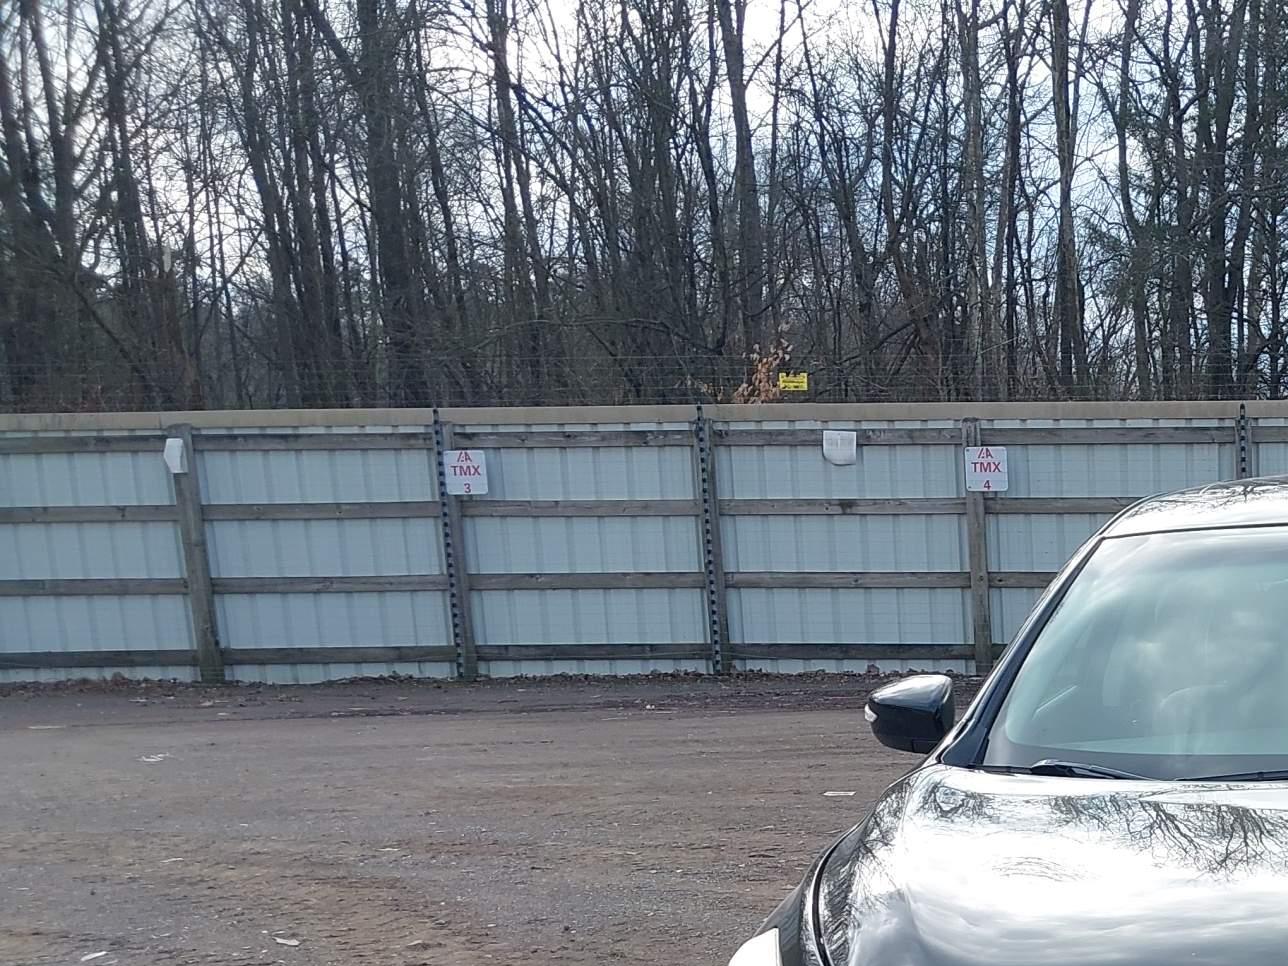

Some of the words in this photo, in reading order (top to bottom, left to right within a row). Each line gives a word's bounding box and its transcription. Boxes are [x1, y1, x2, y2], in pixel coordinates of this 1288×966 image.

[451, 466, 481, 476] TMX
[971, 462, 1001, 472] TMX
[464, 483, 471, 493] 3
[983, 480, 992, 491] 4
